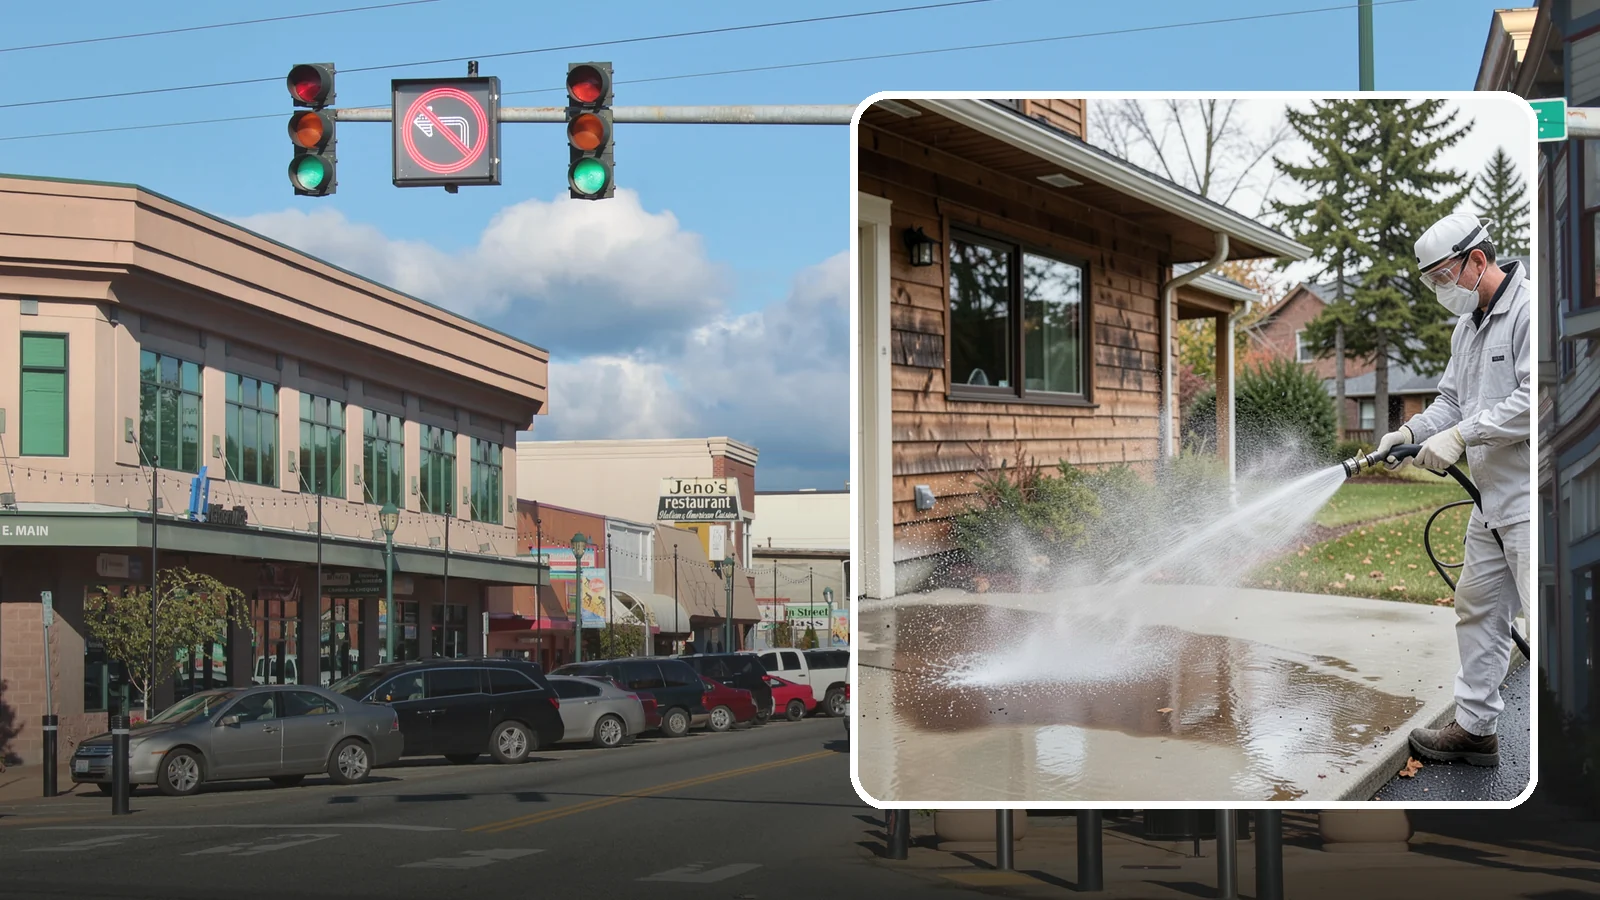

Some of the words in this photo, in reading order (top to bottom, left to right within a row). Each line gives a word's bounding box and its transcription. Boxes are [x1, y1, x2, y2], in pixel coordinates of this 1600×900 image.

[670, 480, 727, 494] Jeno's
[665, 496, 731, 509] restaurant
[659, 510, 681, 520] Italian
[686, 509, 715, 519] American
[715, 509, 737, 519] Cuisine
[2, 525, 13, 536] E.
[15, 525, 49, 536] MAIN
[797, 608, 828, 616] Street
